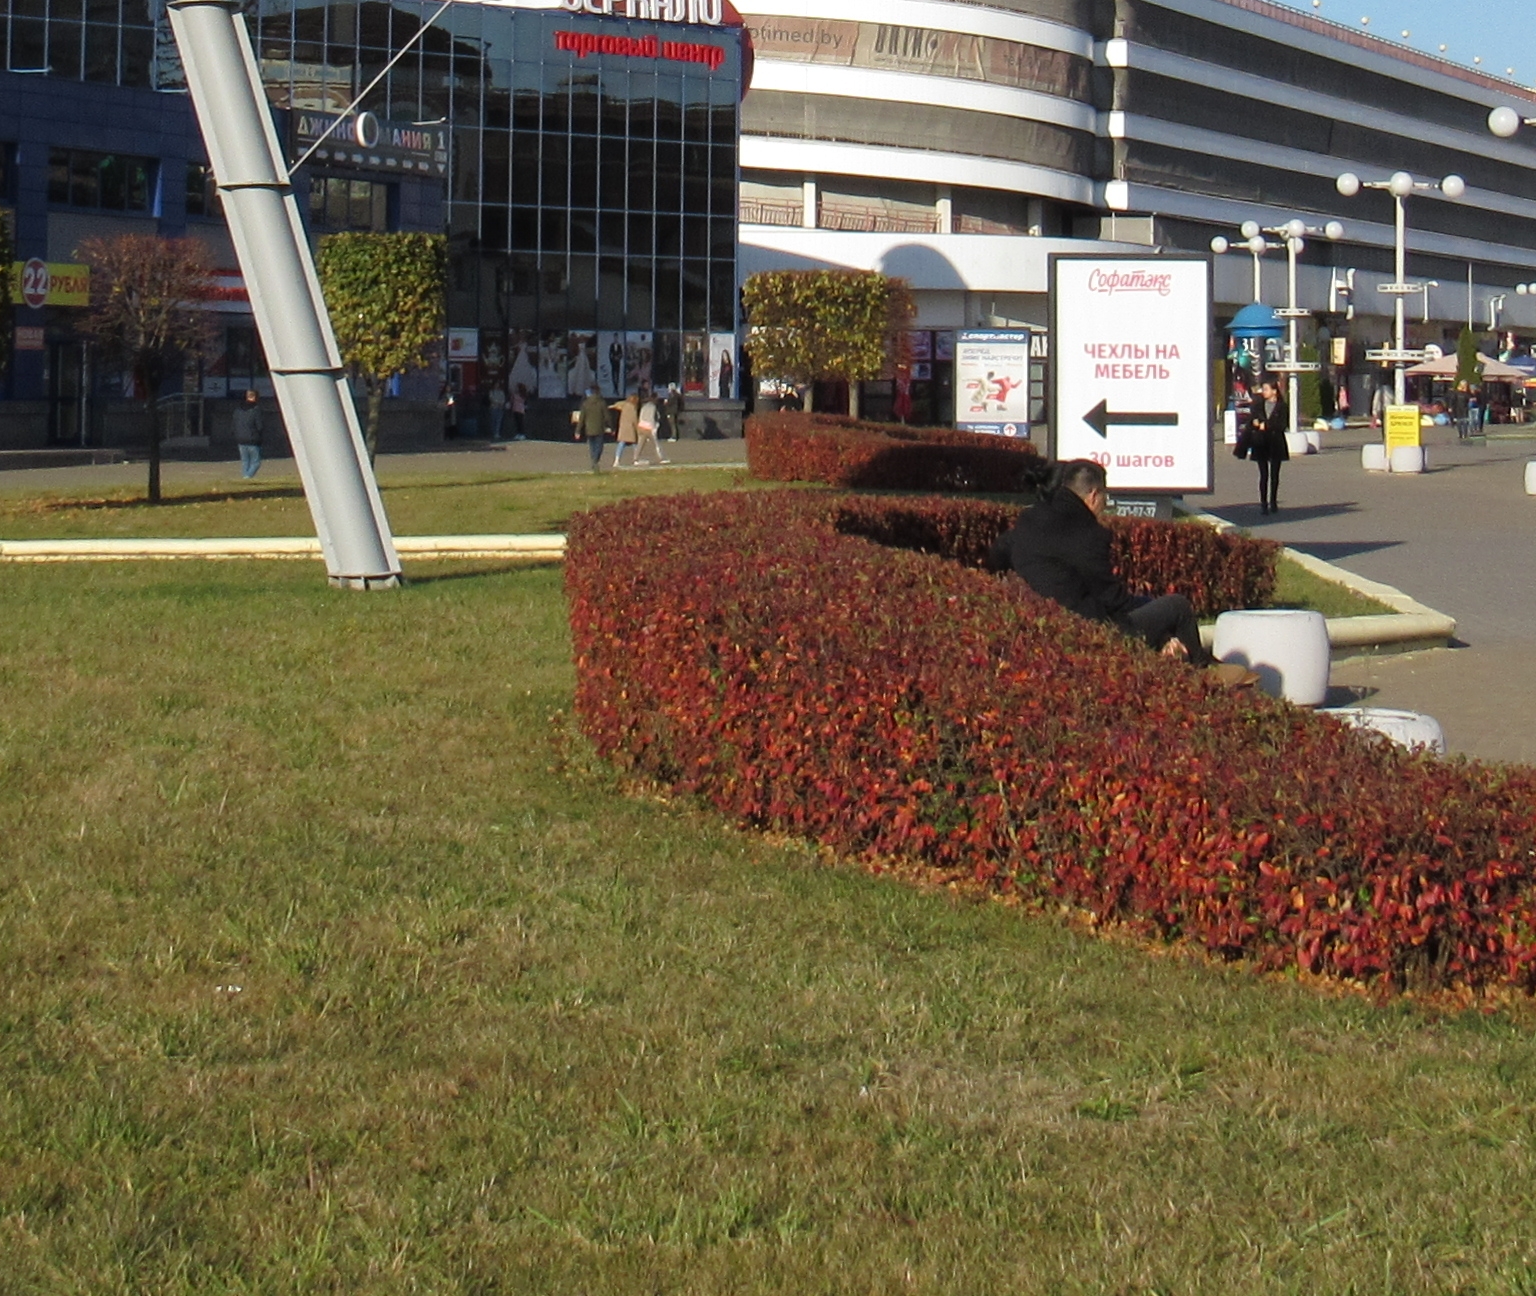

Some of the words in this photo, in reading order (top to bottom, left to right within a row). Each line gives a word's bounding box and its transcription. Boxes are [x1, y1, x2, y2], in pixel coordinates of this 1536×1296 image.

[553, 31, 659, 59] торговый
[662, 40, 725, 71] центр
[24, 267, 48, 295] 22
[1084, 343, 1149, 359] ЧЕХЛЫ
[1155, 344, 1180, 359] НА
[1094, 364, 1170, 380] МЕБЕЛЬ
[1116, 454, 1175, 468] шагов
